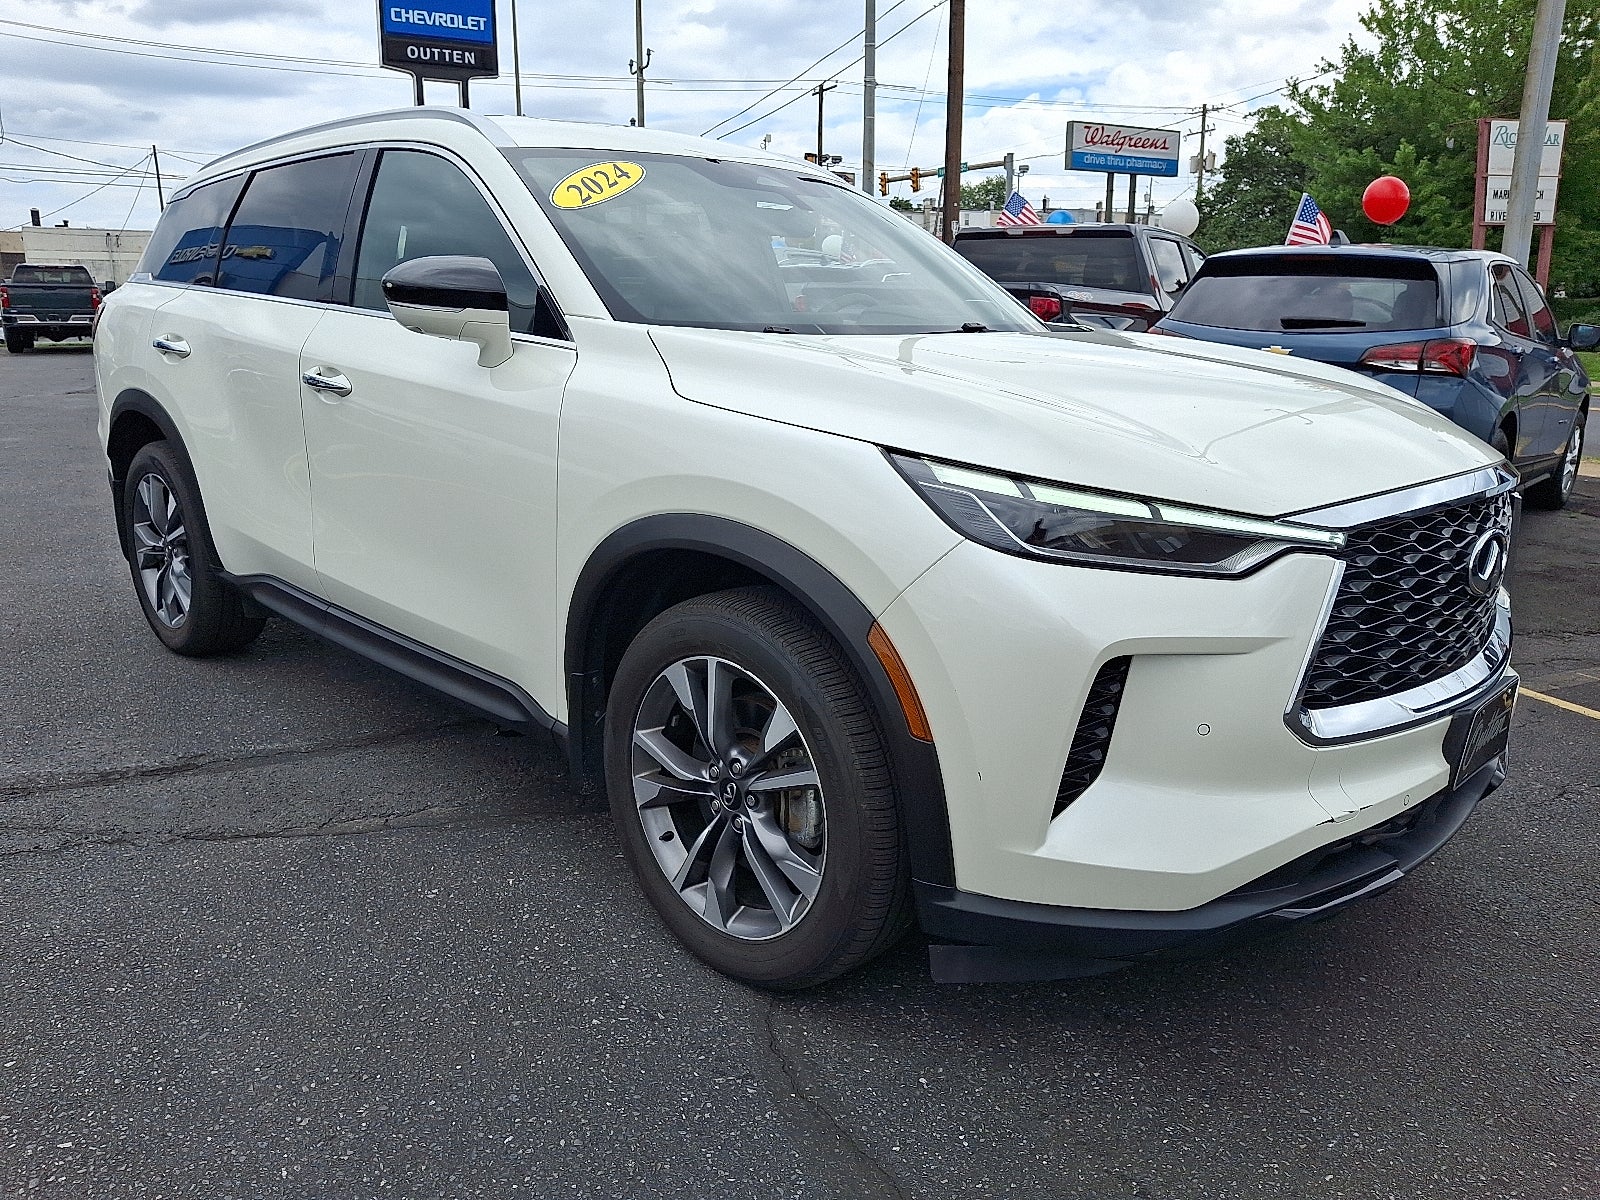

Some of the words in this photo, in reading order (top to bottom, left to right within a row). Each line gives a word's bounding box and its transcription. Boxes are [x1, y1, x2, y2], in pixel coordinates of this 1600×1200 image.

[390, 7, 487, 31] CHEVROLET
[406, 45, 475, 65] OUTTEN
[1083, 125, 1170, 154] Walgreens
[1083, 154, 1105, 166] drive
[1107, 155, 1125, 167] thru
[1126, 157, 1168, 172] pharmacy
[566, 163, 631, 204] 2024
